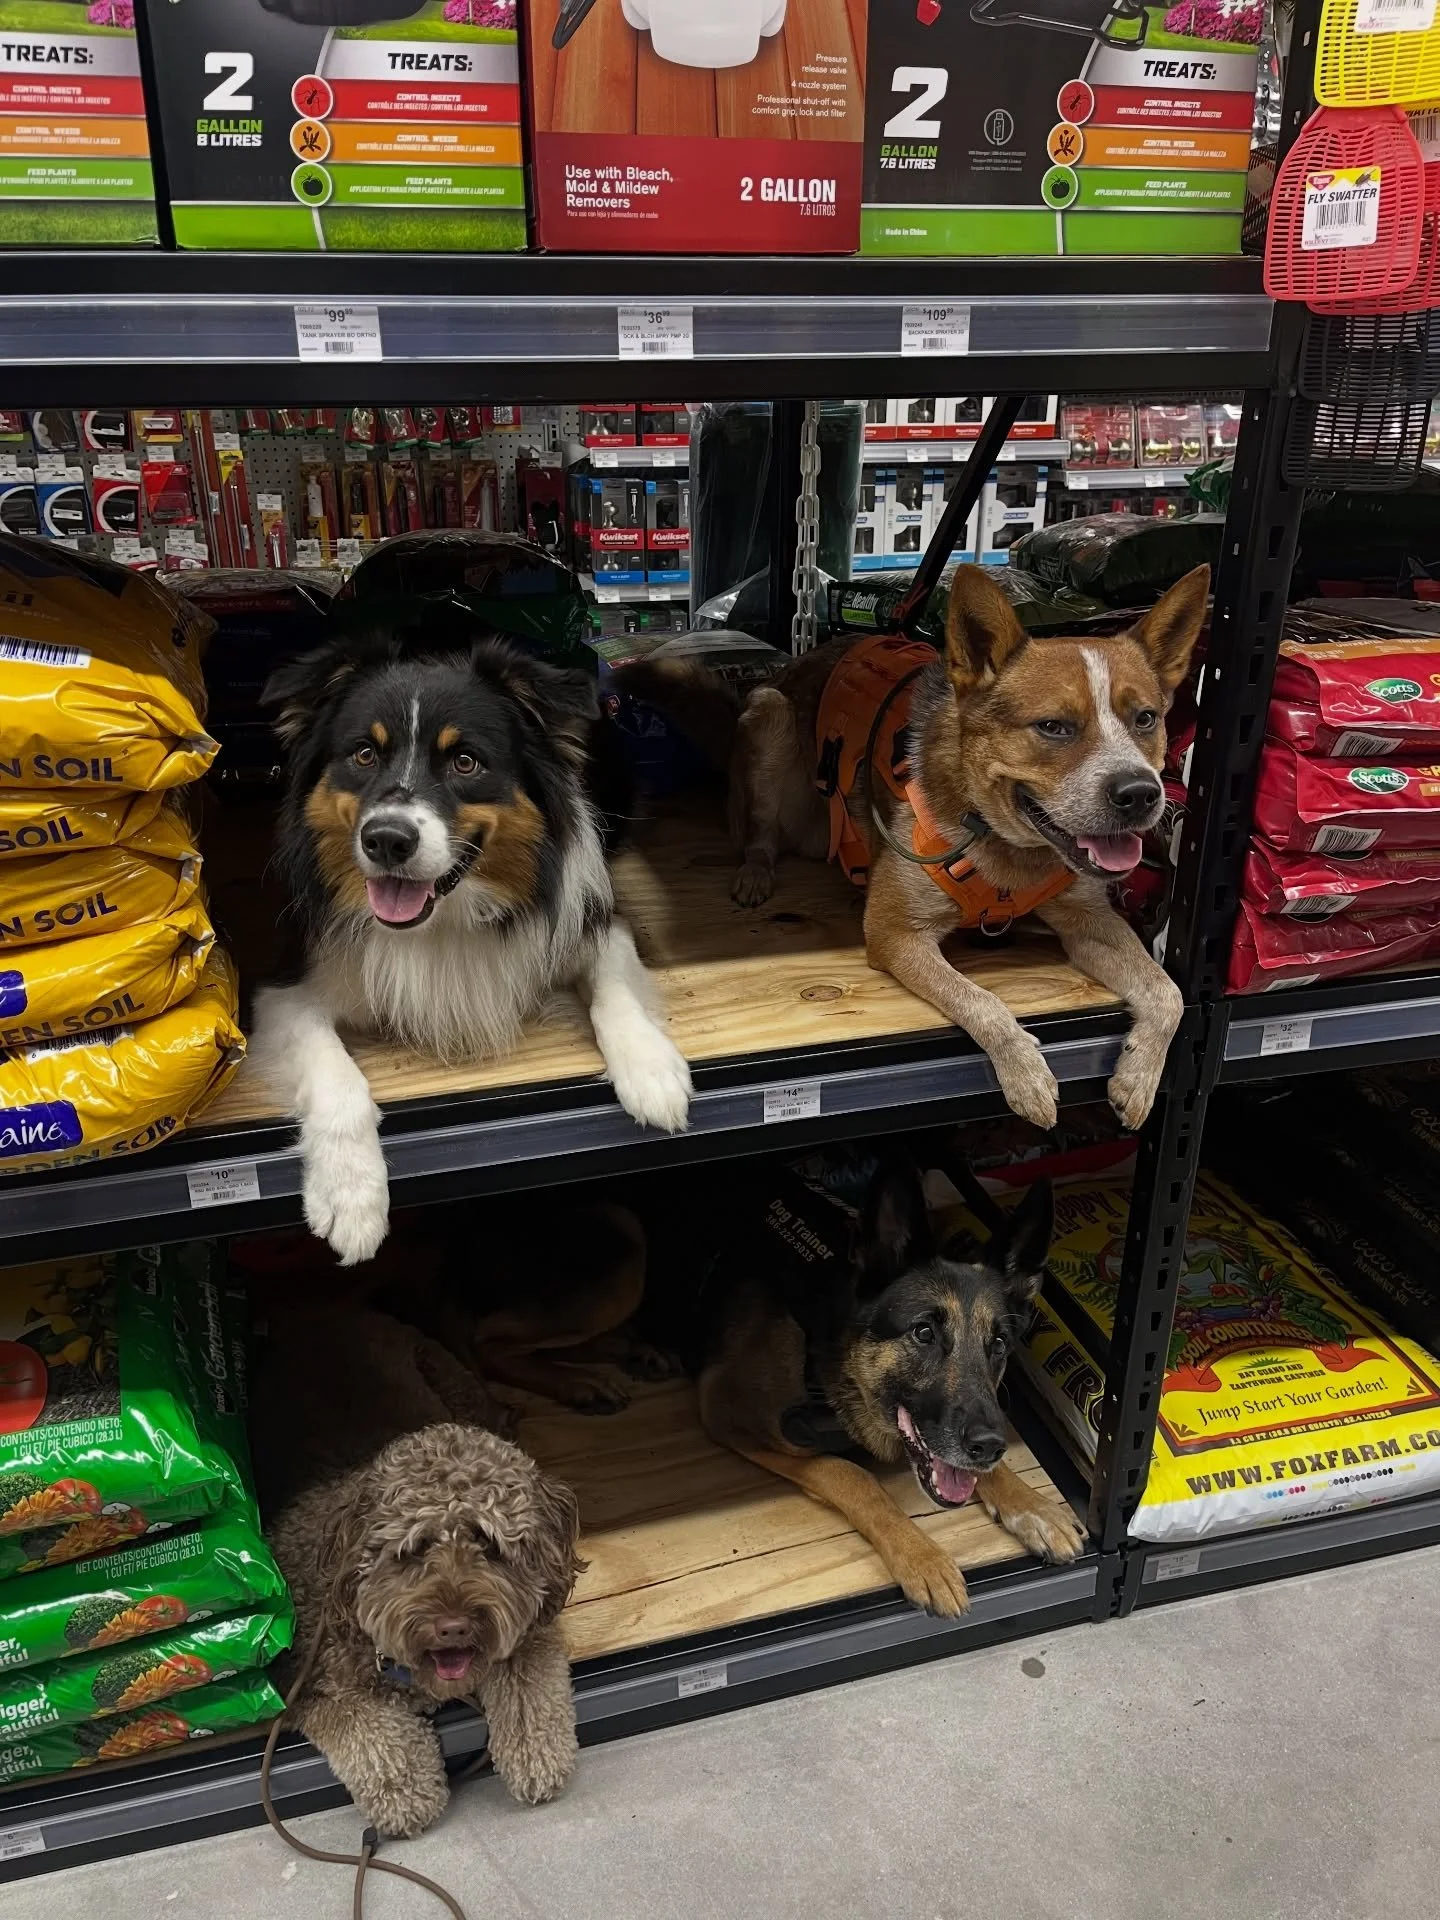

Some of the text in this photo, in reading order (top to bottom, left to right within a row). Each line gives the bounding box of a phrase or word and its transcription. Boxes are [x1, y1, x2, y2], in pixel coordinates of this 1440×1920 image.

[2, 44, 94, 64] TREATS:
[388, 52, 472, 72] TREATS:
[815, 53, 847, 64] Pressure
[801, 65, 847, 75] release valve
[1143, 60, 1217, 80] TREATS:
[203, 52, 254, 111] 2
[798, 80, 820, 89] nozzle
[821, 82, 847, 92] system
[757, 94, 846, 107] Professional shut-off with
[883, 66, 949, 139] 2
[752, 106, 846, 118] comfort grip, lock and filter
[197, 119, 262, 133] GALLON
[210, 134, 262, 147] LITRES
[881, 144, 938, 158] GALLON
[565, 164, 674, 183] Use with Bleach,
[880, 158, 937, 170] 7.6 LITRES
[406, 177, 424, 185] FEED
[565, 180, 659, 195] Mold & Mildew
[740, 176, 836, 203] 2 GALLON
[566, 194, 631, 209] Removers
[1307, 188, 1378, 205] FLY SWATTER
[800, 203, 836, 217] 7.6 LITROS
[885, 228, 928, 236] Made in China
[600, 532, 639, 541] Kwikset
[652, 532, 690, 541] Kwikset
[1371, 682, 1416, 697] Scotts
[32, 754, 123, 782] SOIL
[1358, 771, 1404, 786] Scotts
[0, 816, 83, 852] SOIL
[33, 891, 118, 933] SOIL
[63, 992, 145, 1034] SOIL
[765, 1214, 816, 1263] 386-222-5035
[769, 1199, 835, 1261] Dog Trainer
[1182, 1335, 1211, 1365] SOIL
[1206, 1321, 1317, 1345] CONDITIONER
[1230, 1369, 1326, 1391] EARTHWORM CASTINGS
[1238, 1363, 1304, 1380] BAT GUANO AND
[1197, 1376, 1389, 1426] Jump Start Your Garden!
[0, 1417, 123, 1448] CONTENTS/CONTENIDO NETO:
[1255, 1432, 1268, 1441] FT
[1363, 1409, 1392, 1421] LITERS
[13, 1446, 17, 1458] 1
[20, 1444, 32, 1457] CU
[47, 1438, 61, 1451] PIE
[62, 1432, 94, 1449] CUBICO
[96, 1431, 114, 1445] (28.3
[115, 1429, 123, 1440] L)
[1186, 1430, 1440, 1495] WWW.FOXFARM.CO
[76, 1532, 203, 1575] NET CONTENTS/CONTENIDO NETO:
[105, 1543, 204, 1580] 1 CU FT/ PIE CUBICO (28.3 L)
[0, 1708, 59, 1735] autiful
